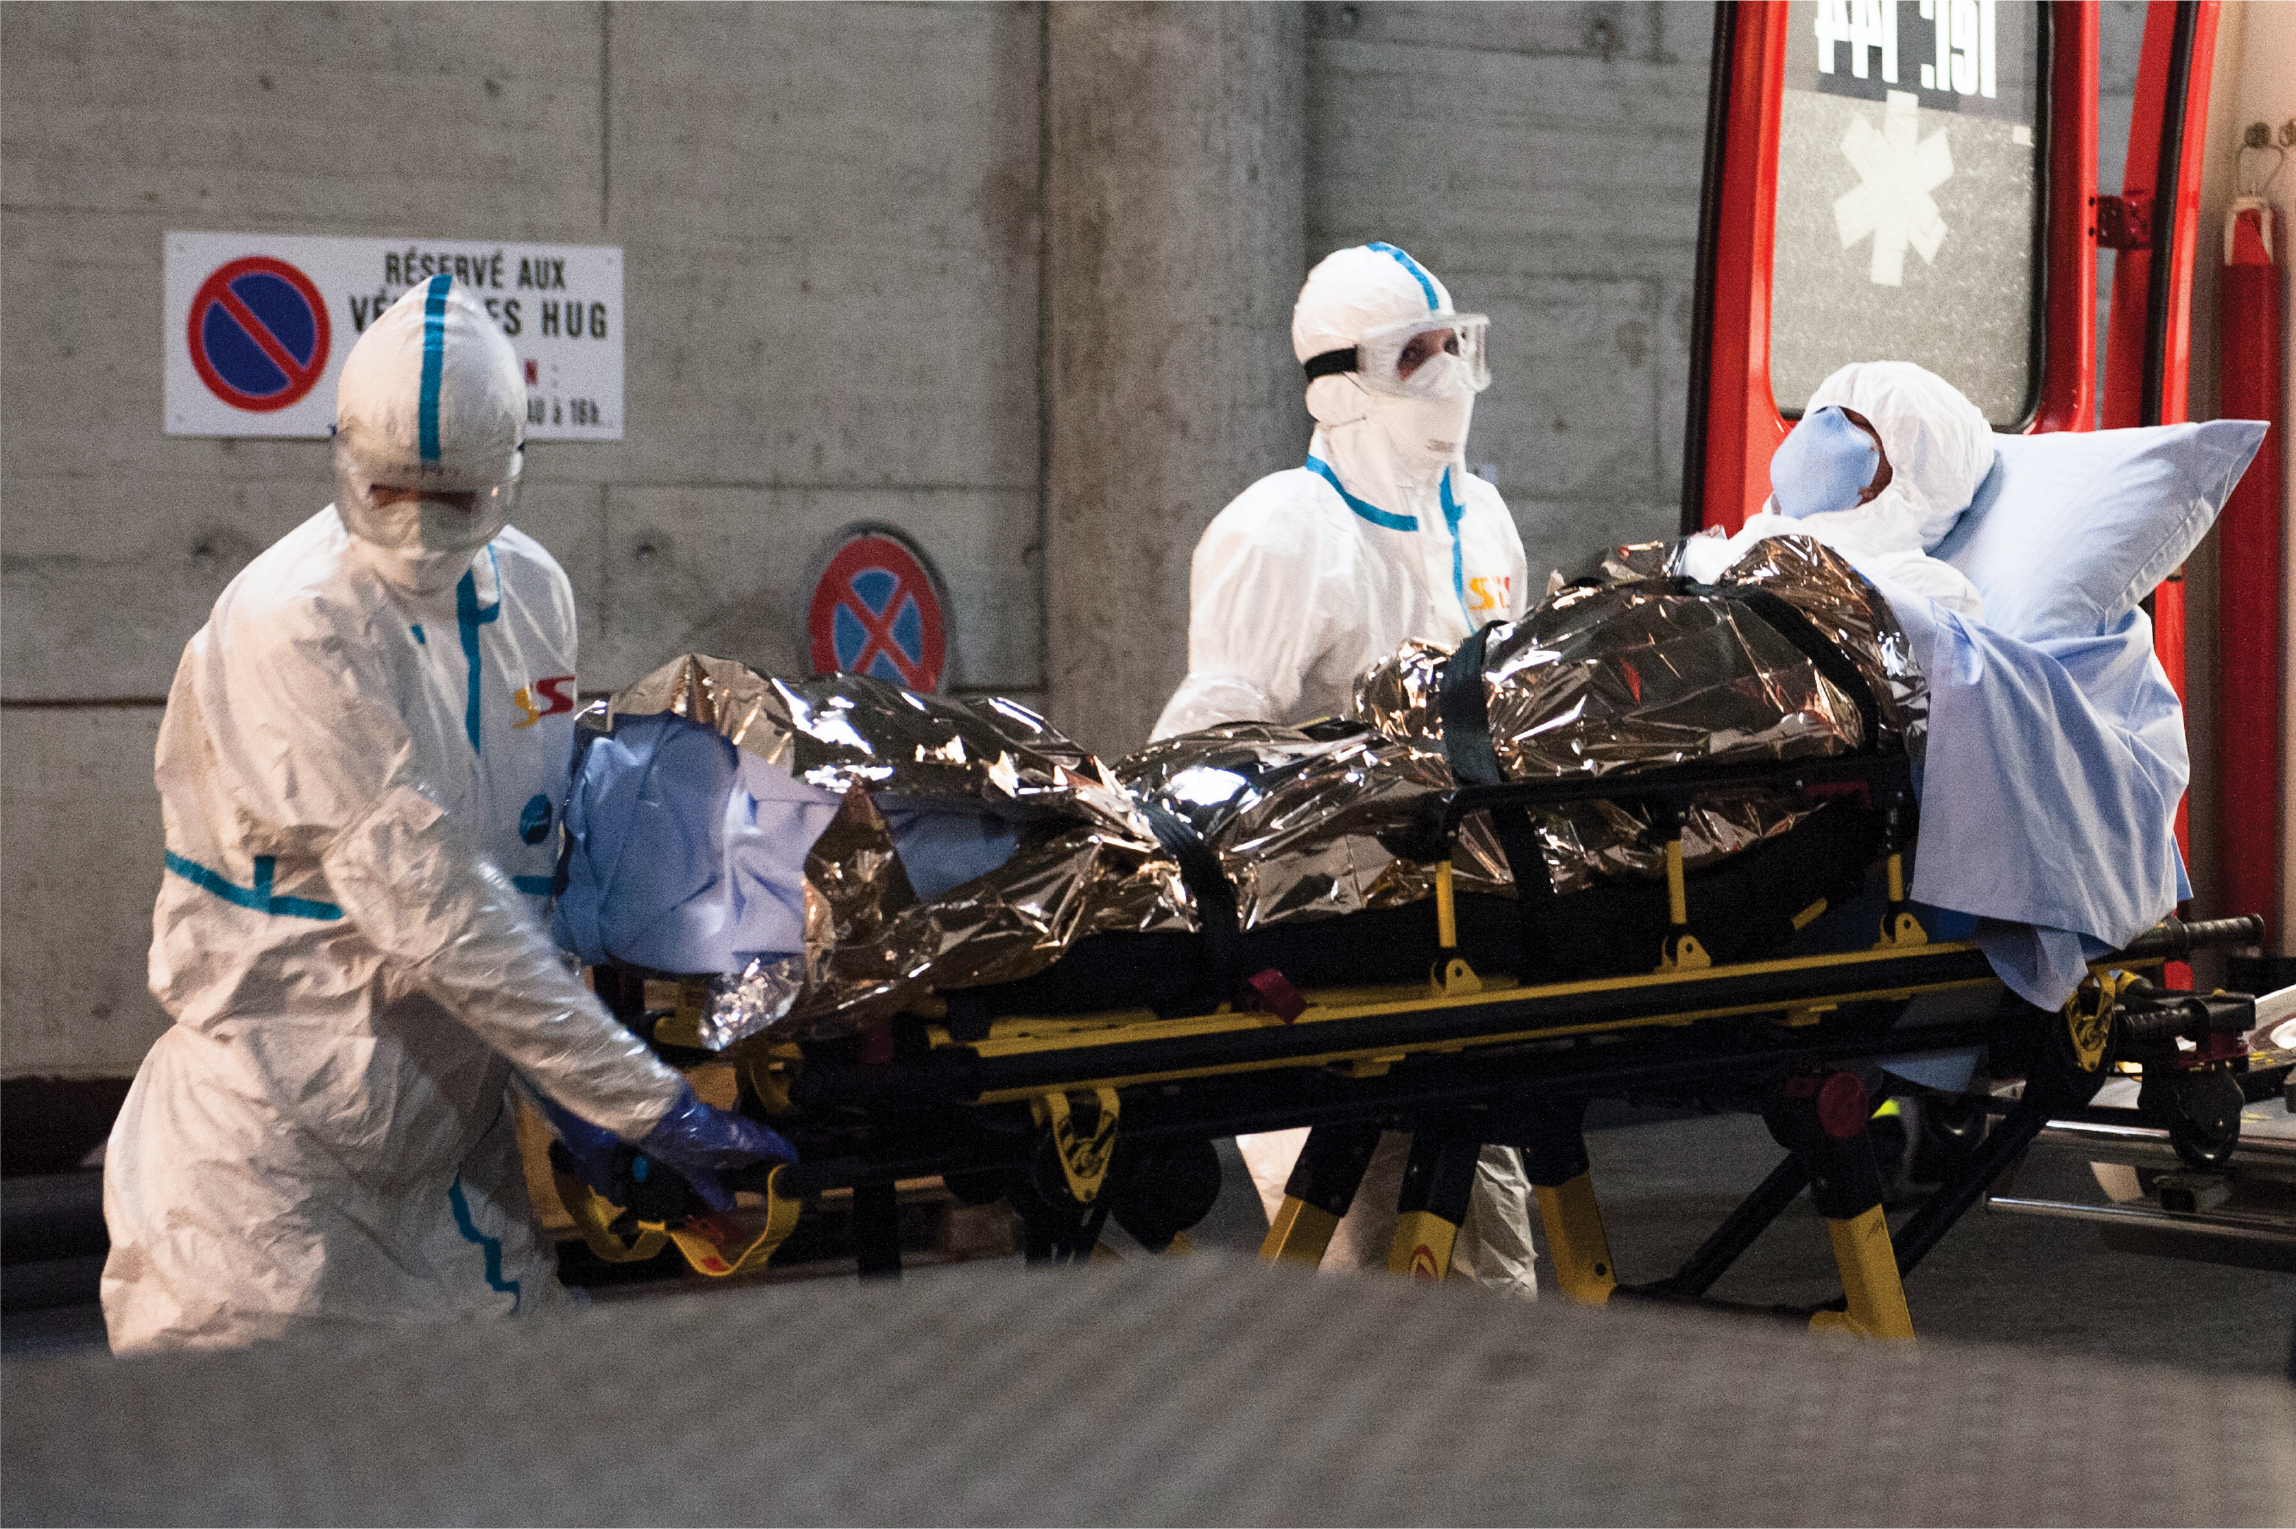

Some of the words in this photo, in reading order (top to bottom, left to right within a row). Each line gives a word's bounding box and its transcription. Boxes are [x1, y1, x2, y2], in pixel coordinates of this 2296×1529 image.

[384, 245, 503, 289] RÉSERVÉ
[517, 254, 566, 291] AUX
[541, 300, 608, 339] HUG
